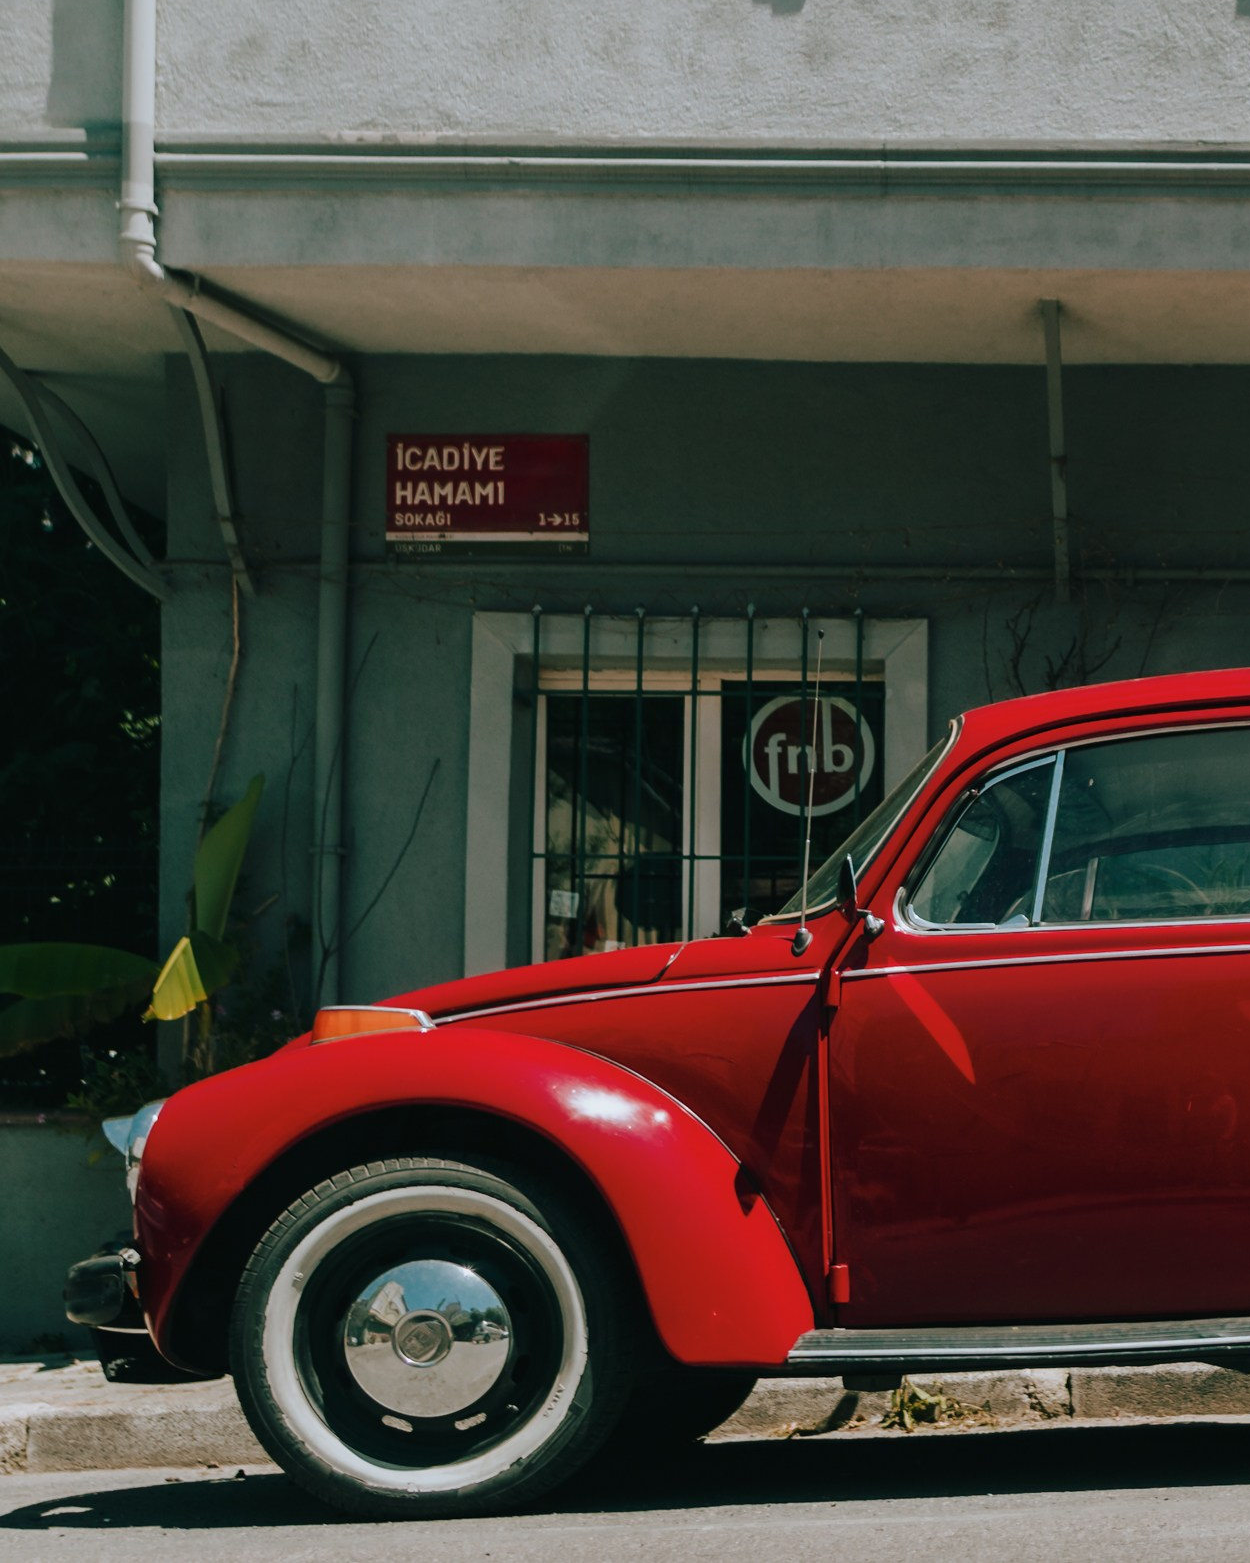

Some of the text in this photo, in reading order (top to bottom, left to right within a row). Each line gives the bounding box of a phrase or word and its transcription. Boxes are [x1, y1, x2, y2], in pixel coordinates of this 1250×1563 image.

[397, 442, 505, 471] İCADİYE
[395, 481, 505, 506] HAMAMI
[395, 511, 451, 527] SOKAĞI
[764, 696, 854, 798] fnb
